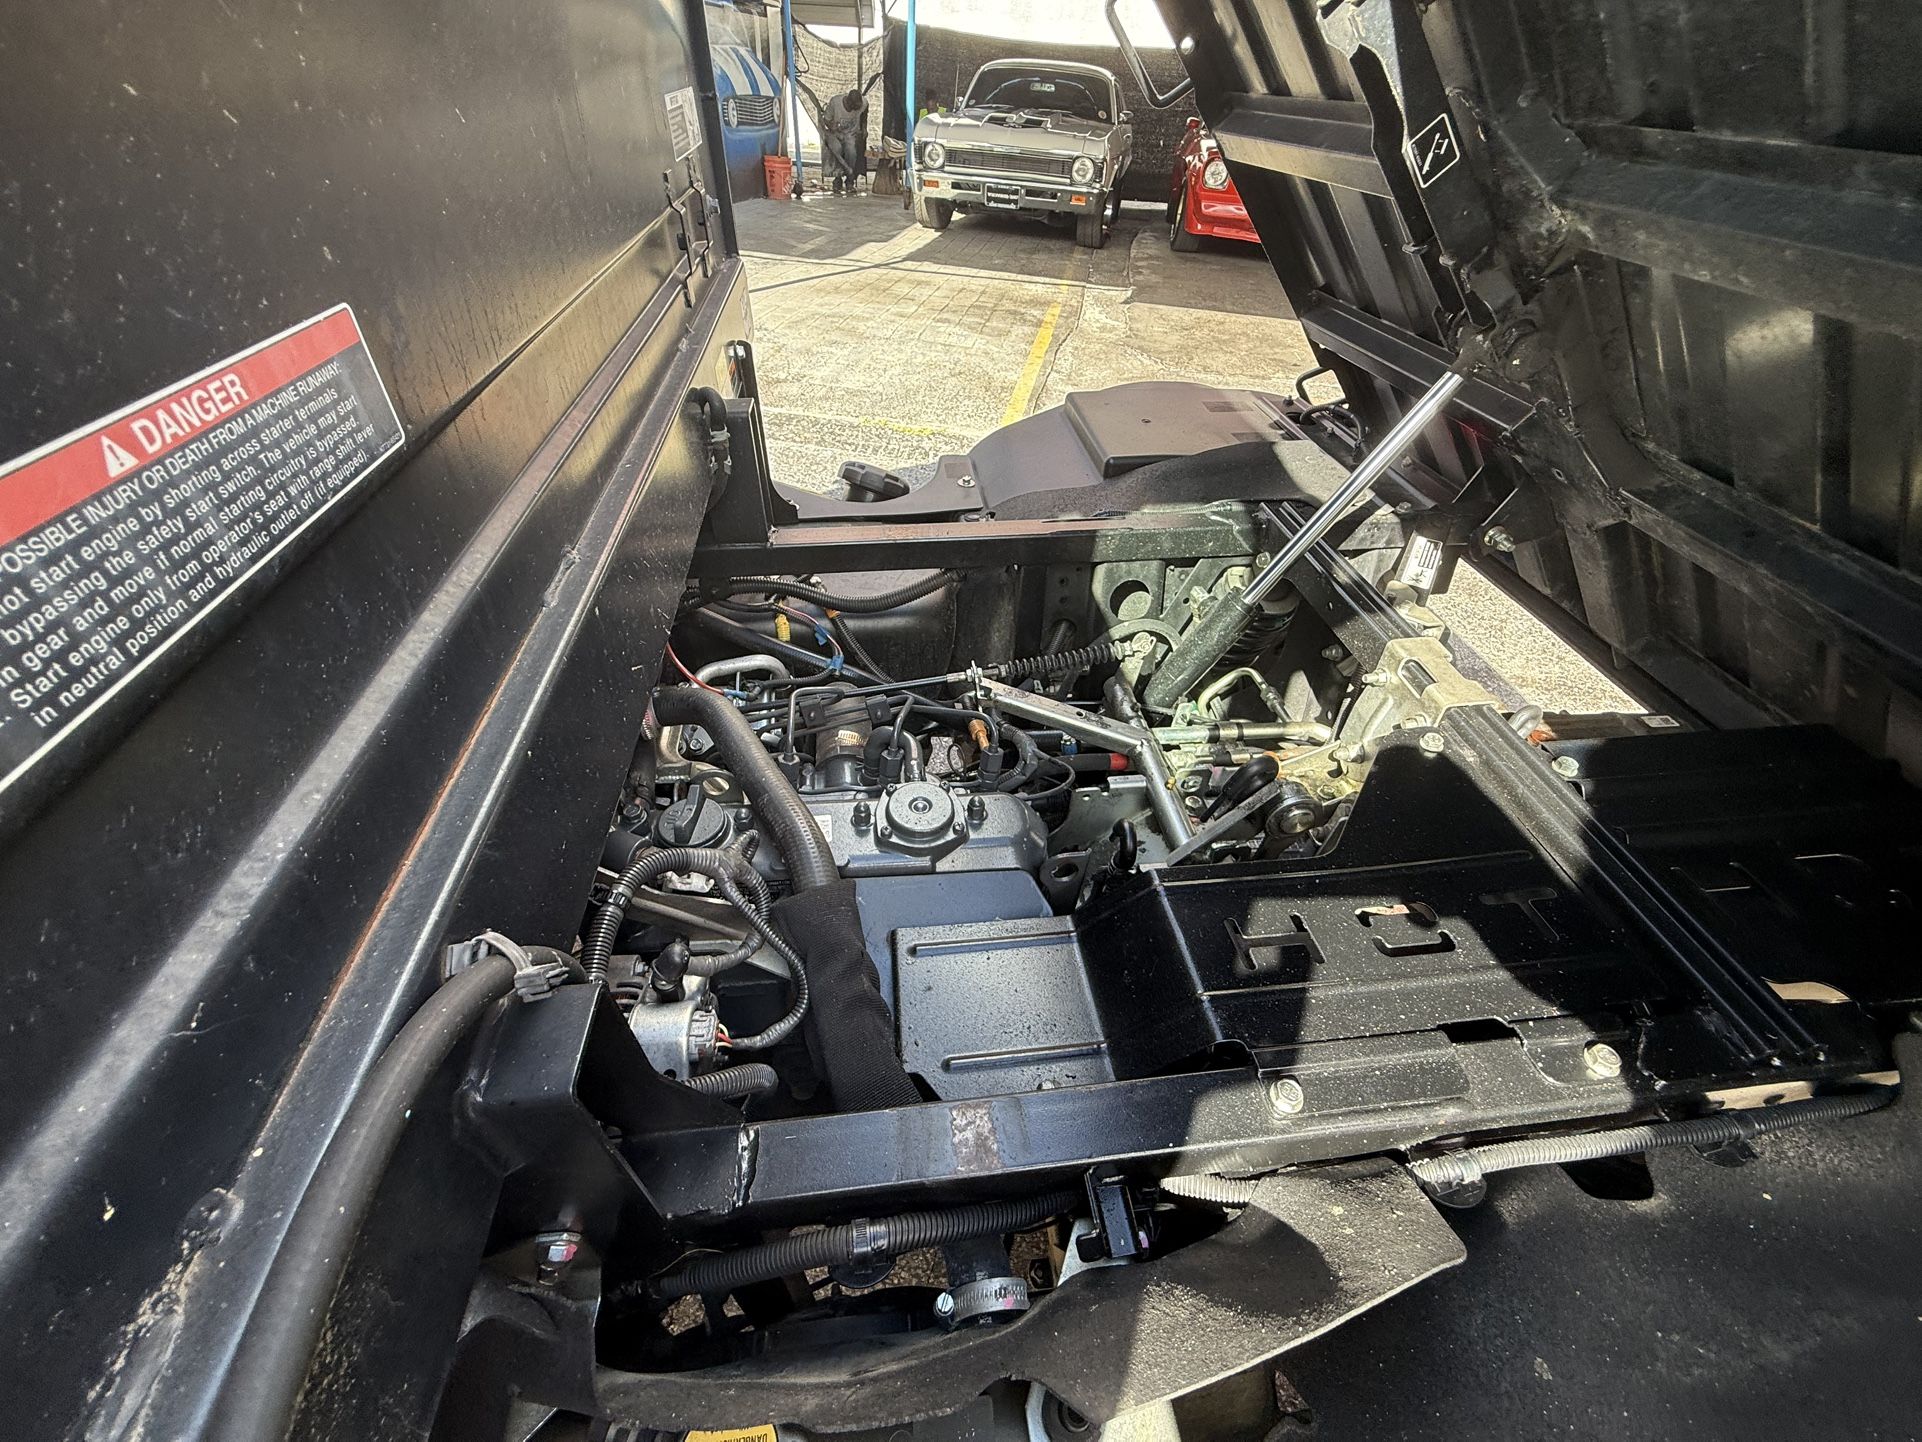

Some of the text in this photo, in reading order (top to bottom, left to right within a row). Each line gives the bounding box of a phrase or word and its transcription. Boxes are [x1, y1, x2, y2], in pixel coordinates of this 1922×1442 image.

[0, 361, 342, 582] OSSIBLE INJURY OR DEATH FROM A MACHINE RUNAWAY:
[0, 394, 358, 645] bypassing the safety start switch. The vehicle may start
[30, 553, 80, 594] start
[80, 517, 140, 561] engine
[138, 502, 163, 522] by
[163, 465, 221, 508] shorting
[220, 439, 260, 471] across
[260, 415, 295, 445] starter
[294, 388, 338, 421] terminals
[130, 373, 249, 454] DANGER
[10, 662, 69, 708] Start
[68, 616, 130, 666] engine
[131, 586, 167, 618] only
[165, 560, 201, 590] from
[202, 511, 264, 563] operator's
[263, 490, 289, 516] seat
[287, 473, 310, 497] with
[309, 454, 336, 480] range
[335, 438, 356, 459] shift
[353, 423, 375, 445] lever
[22, 627, 70, 671] gear
[72, 596, 110, 632] and
[109, 566, 156, 603] move
[153, 551, 170, 569] if
[170, 516, 219, 559] normal
[219, 485, 266, 524] starting
[264, 453, 307, 490] circuitry
[306, 447, 317, 460] is
[315, 415, 360, 452] bypassed.
[30, 706, 59, 728] in
[58, 647, 126, 707] neutral
[125, 598, 188, 656] position
[188, 572, 217, 602] and
[213, 530, 270, 579] hydraulic
[270, 504, 301, 535] outlet
[300, 490, 315, 510] off
[314, 483, 327, 500] (if
[327, 449, 370, 487] equipped).
